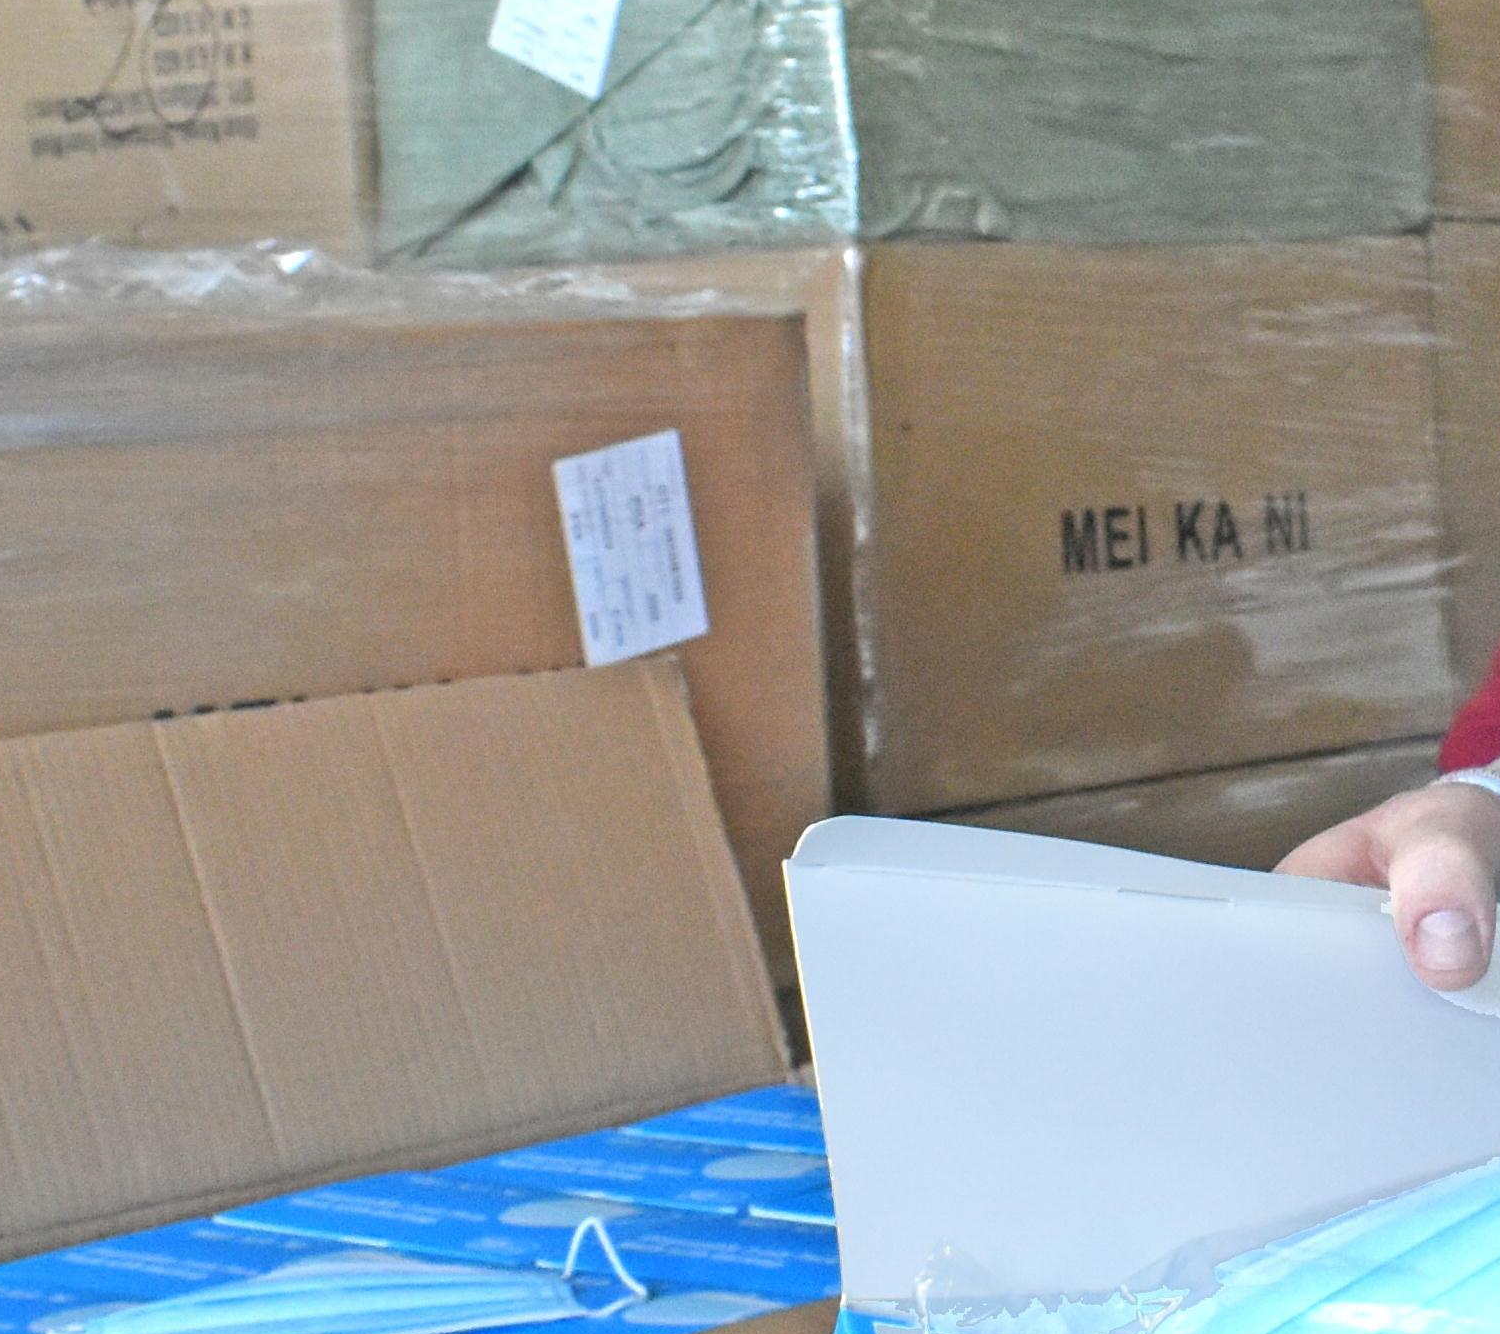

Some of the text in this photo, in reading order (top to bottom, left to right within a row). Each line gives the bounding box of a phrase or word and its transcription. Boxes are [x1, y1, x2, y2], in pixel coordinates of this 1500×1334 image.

[1060, 491, 1311, 574] MEI KA NI
